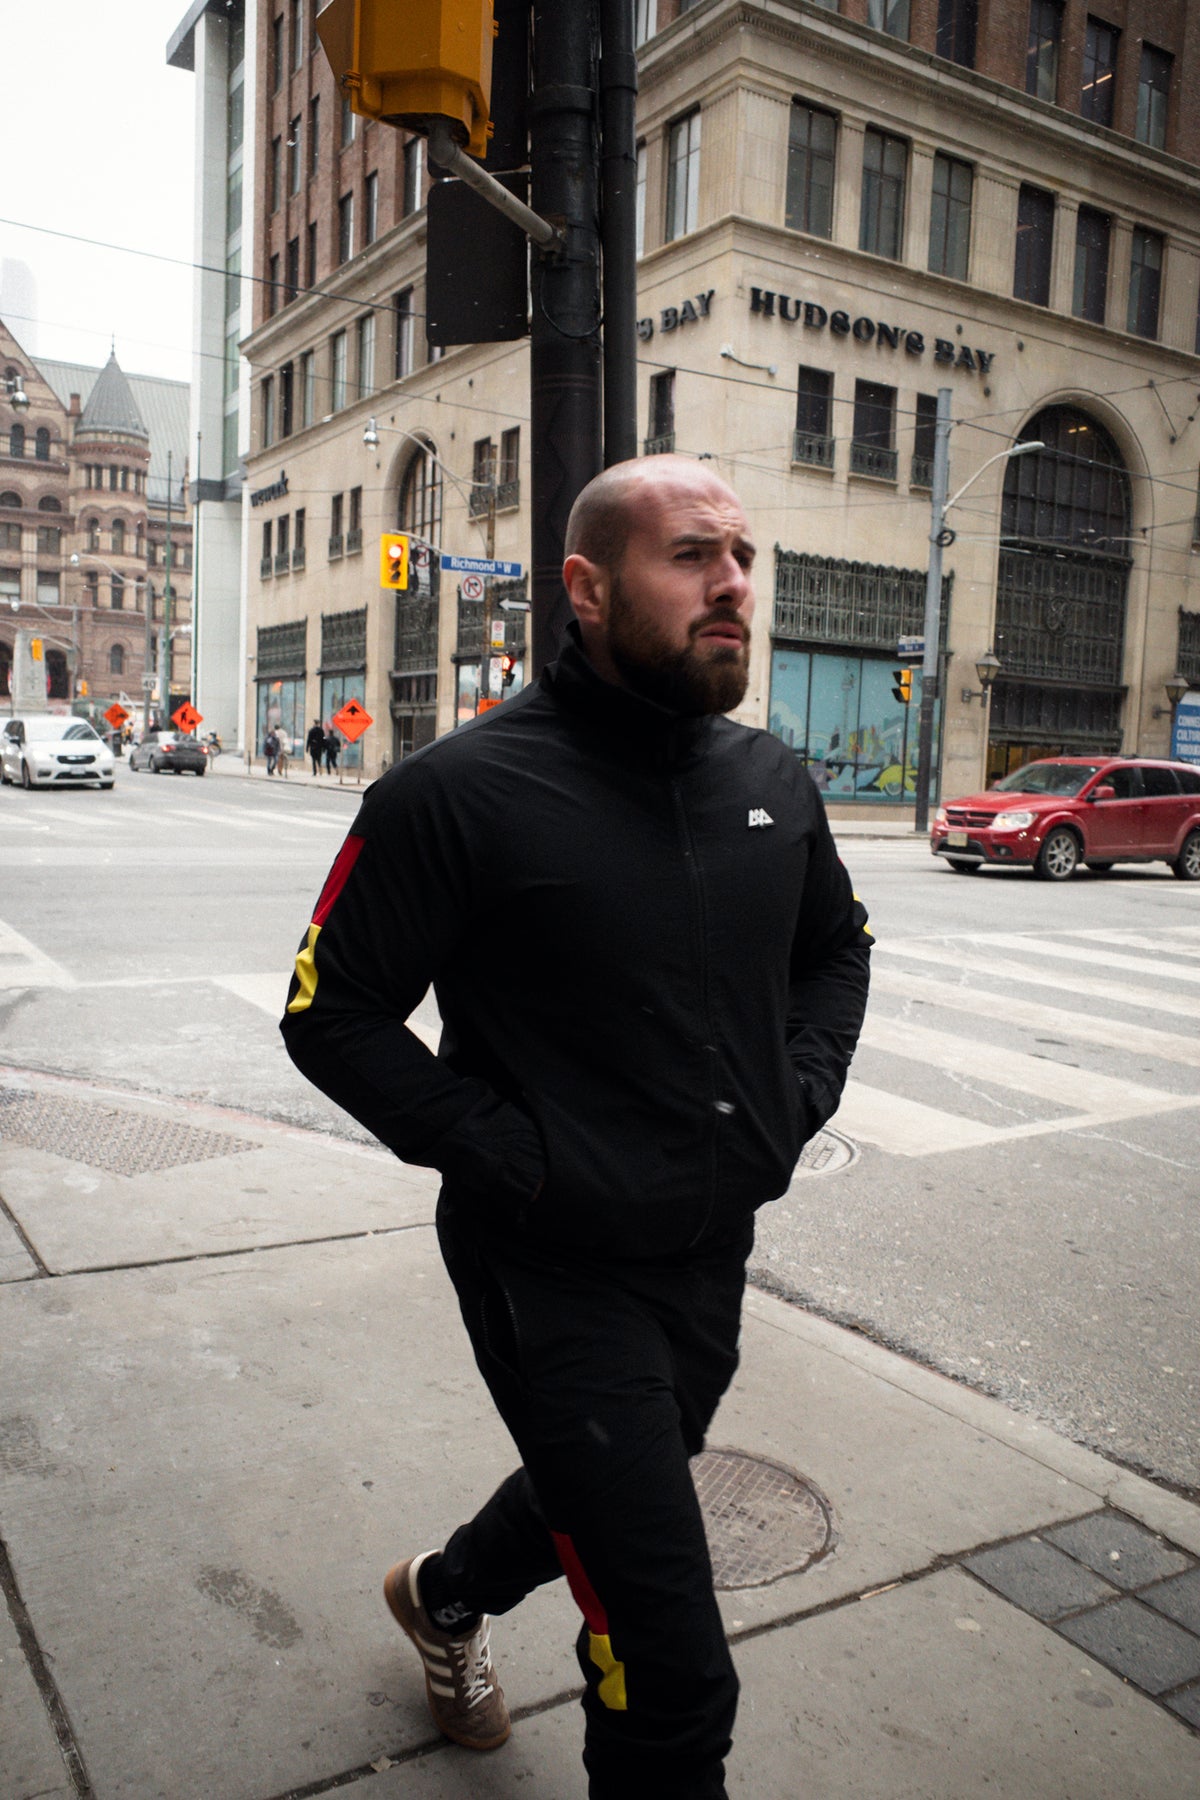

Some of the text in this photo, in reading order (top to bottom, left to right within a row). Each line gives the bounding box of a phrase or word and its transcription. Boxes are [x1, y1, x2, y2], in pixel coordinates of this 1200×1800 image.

[660, 289, 715, 334] BAY
[750, 286, 995, 373] HUDSON'S BAY
[451, 557, 496, 572] Richmond
[503, 562, 512, 573] W
